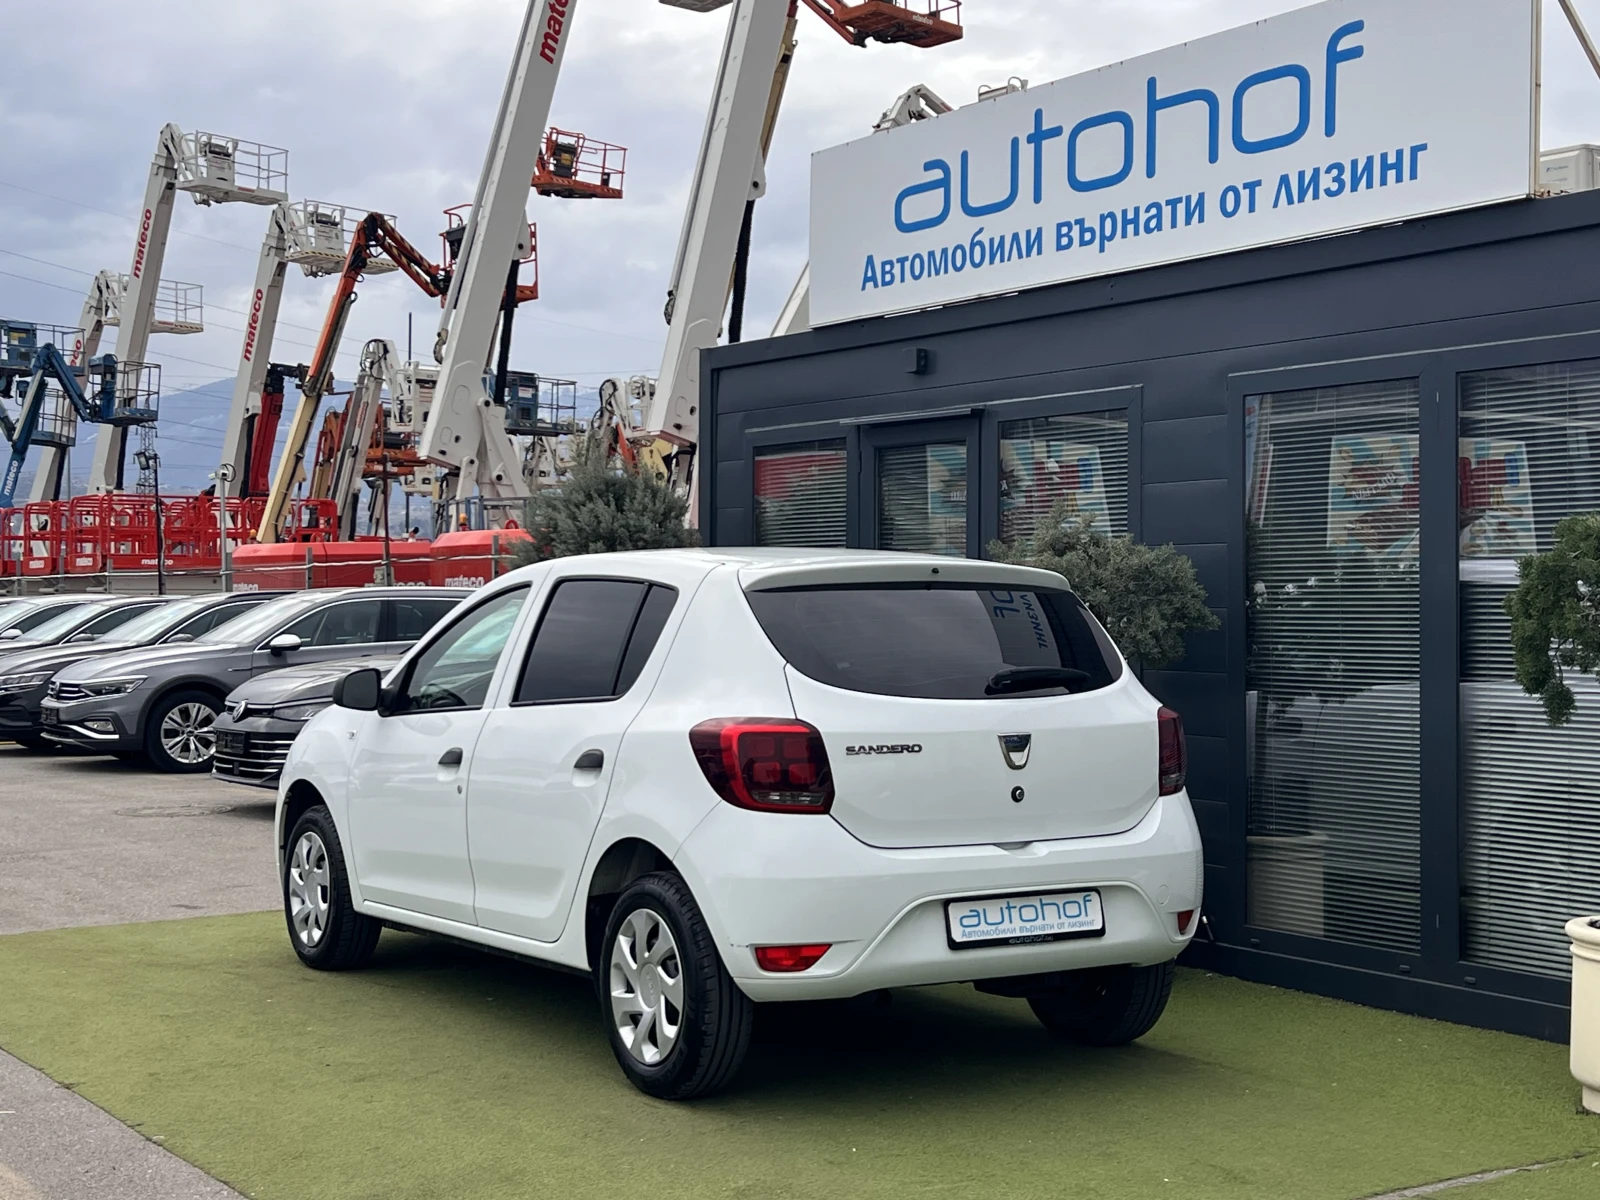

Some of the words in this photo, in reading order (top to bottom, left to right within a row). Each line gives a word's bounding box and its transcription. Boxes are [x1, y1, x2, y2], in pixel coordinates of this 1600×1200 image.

[894, 20, 1364, 234] autohof
[861, 227, 1043, 291] Автомобили
[1056, 192, 1205, 253] върнати
[1219, 179, 1262, 219] от
[1272, 143, 1428, 209] лизинг
[133, 208, 152, 279] mateco
[243, 288, 264, 362] mateco
[71, 339, 82, 366] eco
[3, 460, 19, 496] mateco
[141, 558, 174, 566] matco
[445, 574, 485, 588] mateco
[845, 744, 923, 756] SANDERO
[959, 894, 1092, 928] autohof
[961, 925, 1016, 938] Автомобили
[1019, 921, 1055, 935] върнати
[1057, 922, 1065, 930] от
[1067, 919, 1096, 929] лизинг
